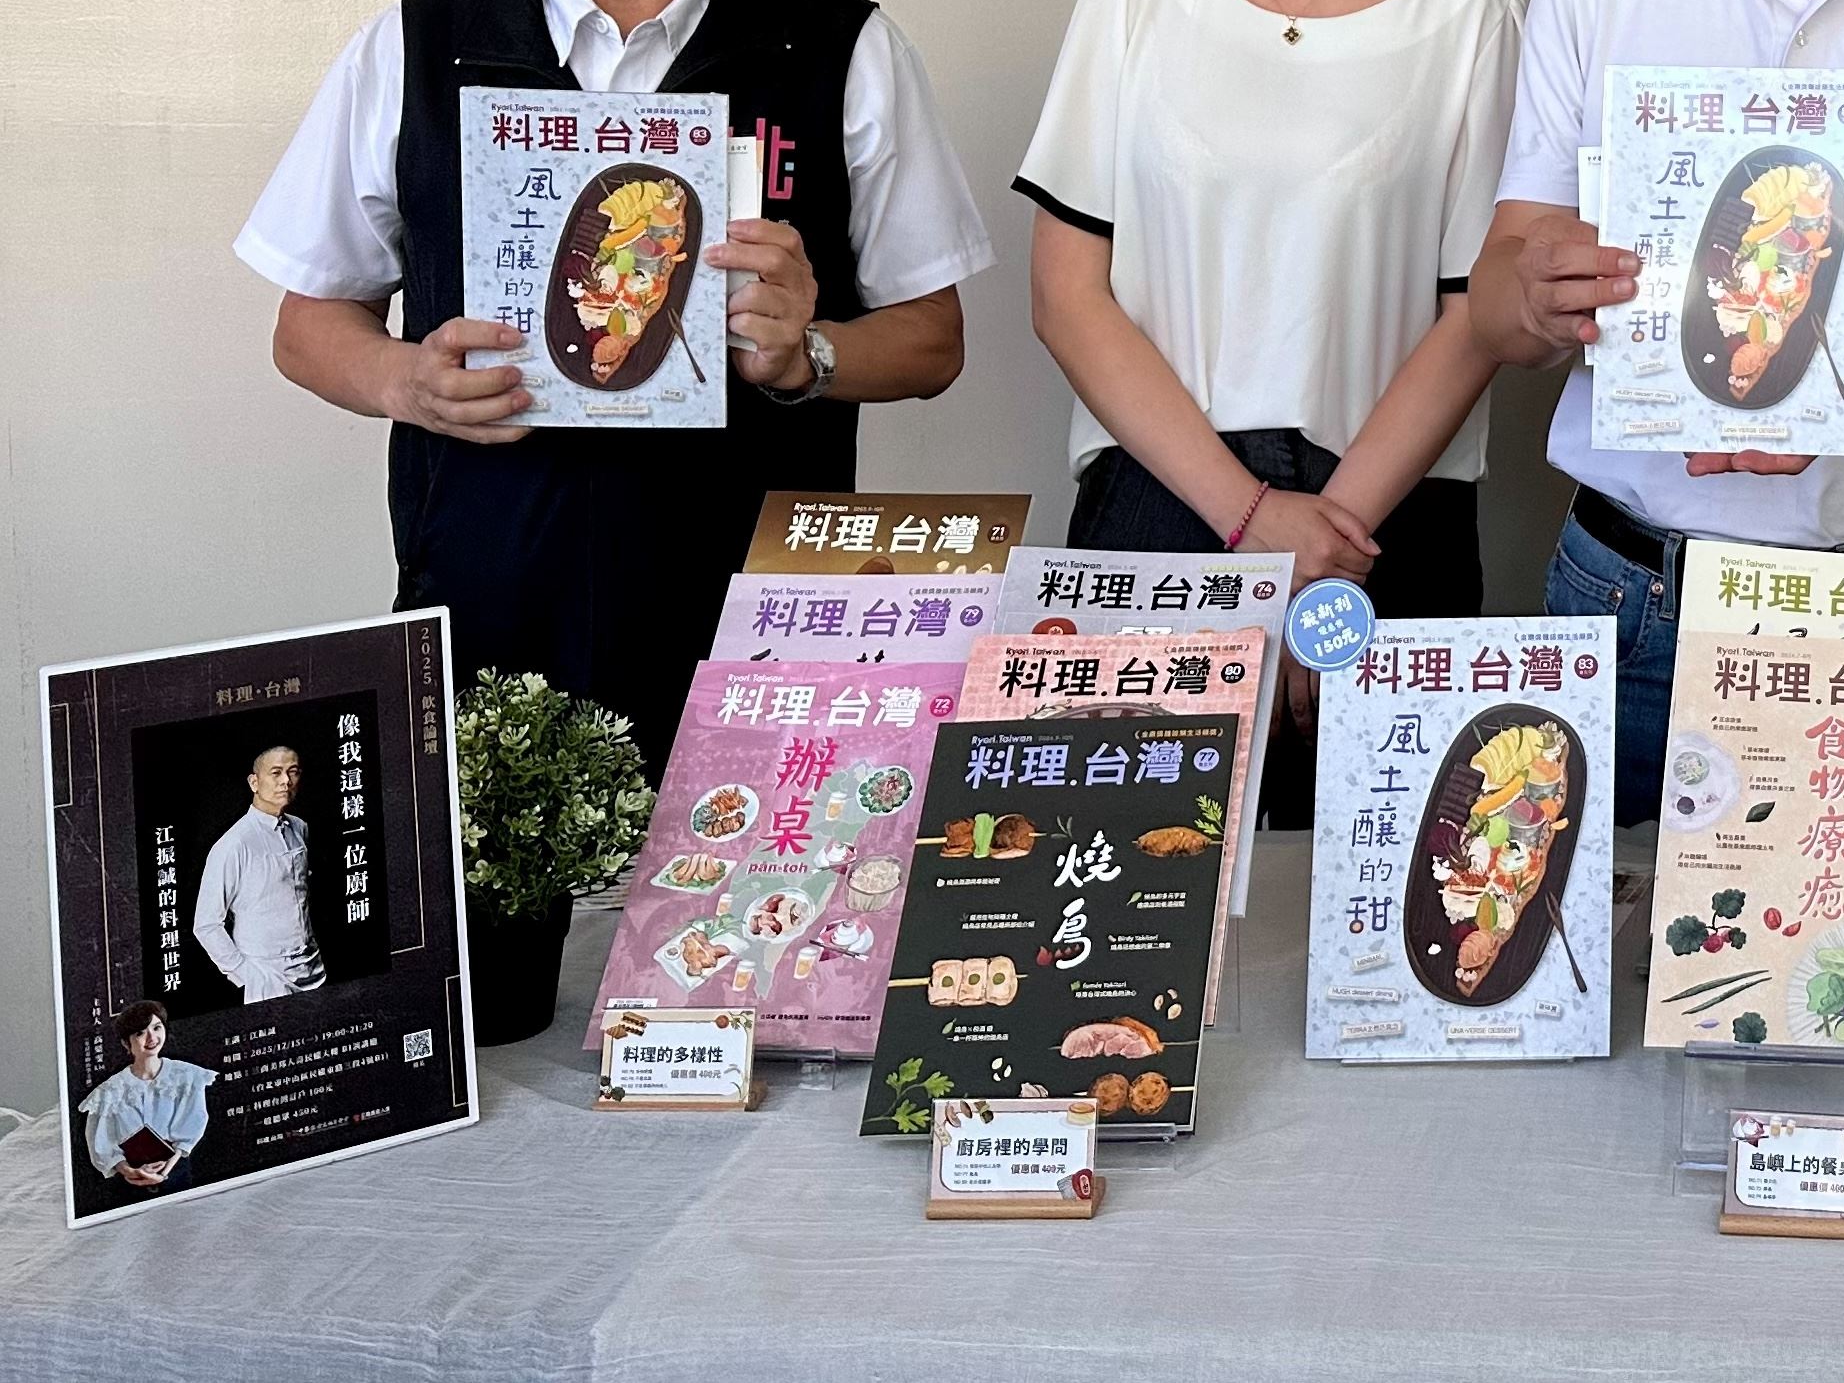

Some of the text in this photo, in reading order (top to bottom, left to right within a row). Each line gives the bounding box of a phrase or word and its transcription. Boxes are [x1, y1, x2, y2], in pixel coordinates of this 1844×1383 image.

[493, 113, 679, 154] 料理.台灣
[693, 130, 707, 138] 83
[496, 168, 561, 334] 風土釀的甜
[1628, 151, 1704, 343] 風土釀的甜
[785, 513, 981, 554] 料理.台灣
[991, 526, 1005, 536] 71
[1038, 570, 1243, 611] 料理.台灣
[1257, 584, 1272, 593] 74
[752, 598, 951, 637] 料理.台灣
[965, 608, 979, 618] 79
[1300, 593, 1353, 629] 最新刊
[1314, 627, 1360, 657] 150元
[1000, 656, 1210, 697] 料理.台灣
[1224, 666, 1241, 675] 80
[1356, 645, 1564, 694] 料理.台灣
[1578, 659, 1594, 669] 83
[717, 684, 922, 728] 料理.台灣
[935, 699, 950, 708] 72
[422, 693, 438, 756] 飲食論壇
[965, 740, 1184, 789] 料理.台灣
[1199, 752, 1215, 761] 77
[760, 736, 840, 857] 辦桌
[336, 715, 370, 925] 像我這樣一位廚師
[1346, 714, 1430, 934] 風土釀的甜
[155, 825, 182, 993] 江振誠的料理世界
[1053, 830, 1122, 969] 燒鳥
[623, 1046, 724, 1064] 料理的多樣性
[957, 1138, 1068, 1157] 廚房裡的學問
